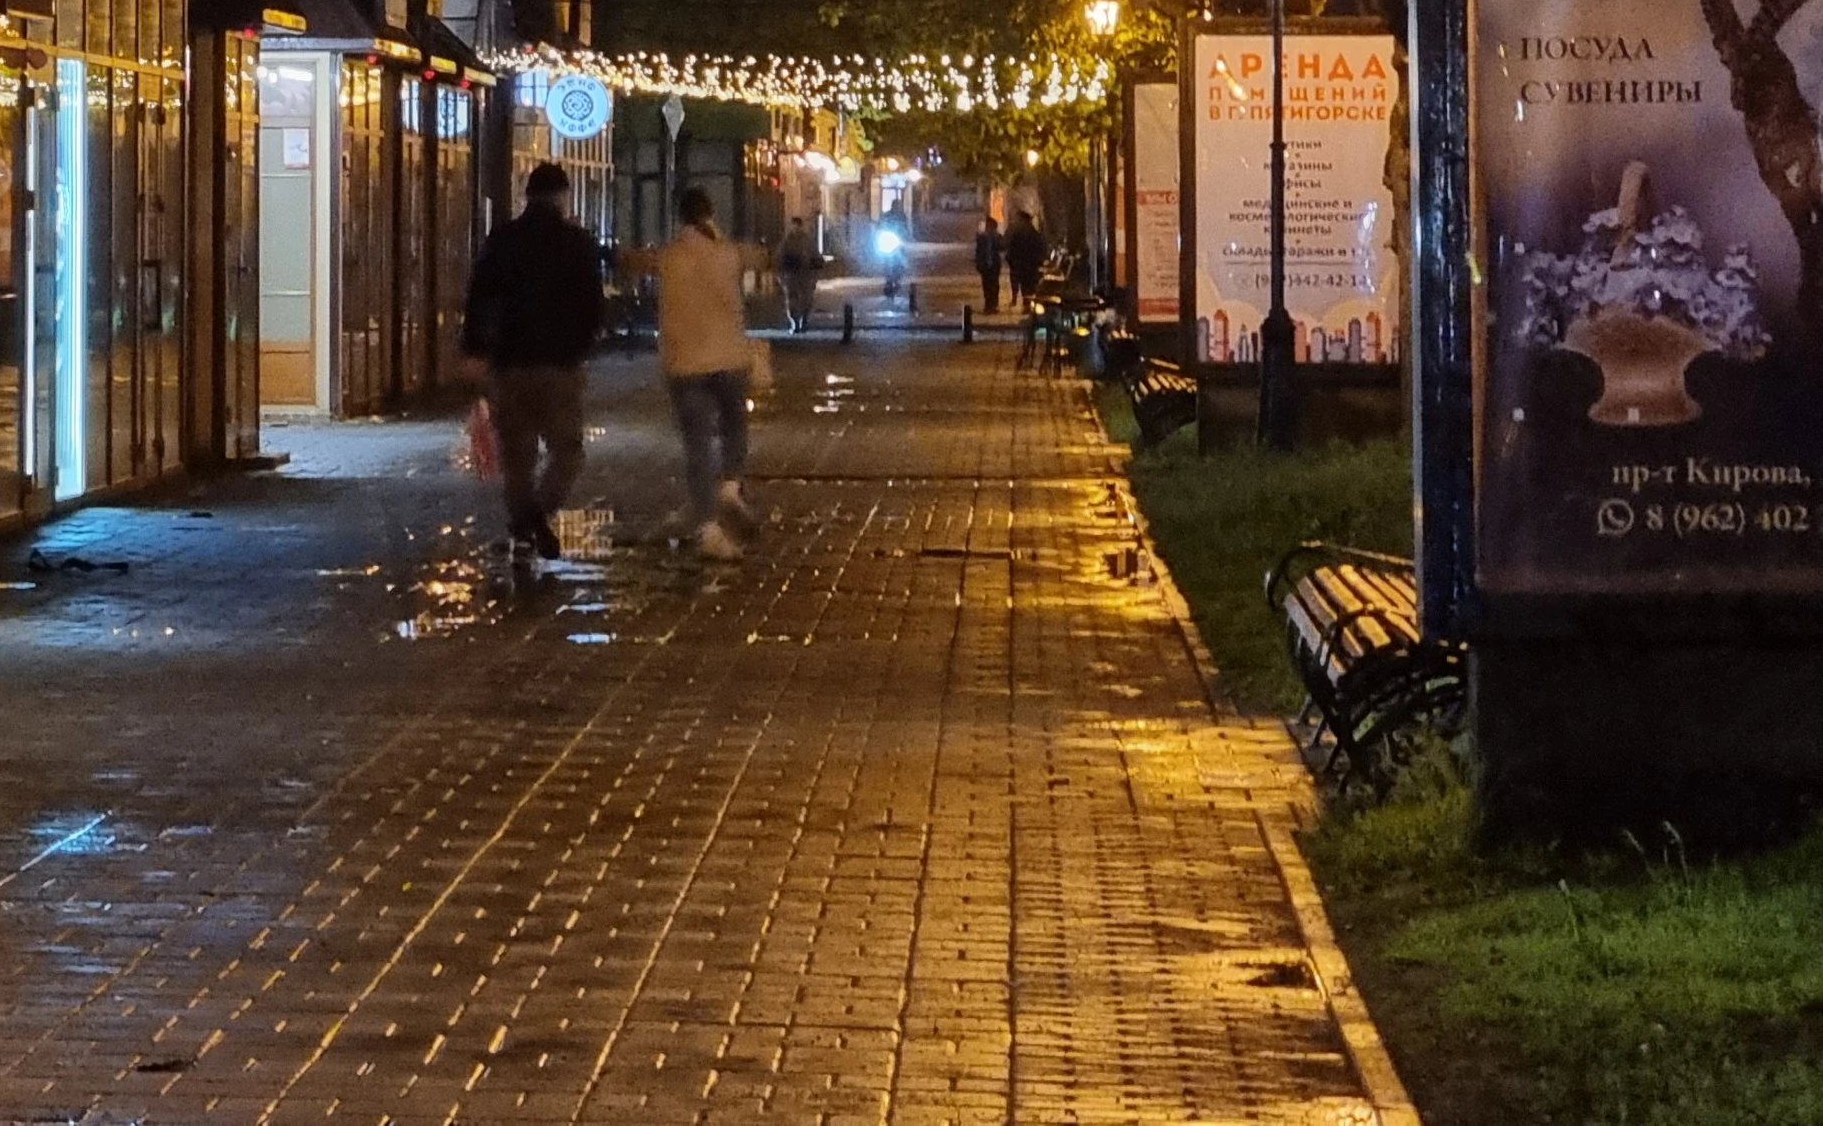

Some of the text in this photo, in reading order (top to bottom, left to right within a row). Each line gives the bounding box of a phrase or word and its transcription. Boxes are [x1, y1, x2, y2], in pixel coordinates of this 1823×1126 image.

[1520, 35, 1655, 64] ПОСУДА
[1209, 52, 1386, 81] АРНДА
[1520, 80, 1703, 104] СУВЕНИРЫ
[1209, 105, 1221, 121] В
[1612, 465, 1676, 493] пр-т
[1645, 504, 1664, 531] 8
[1674, 502, 1745, 538] (962)
